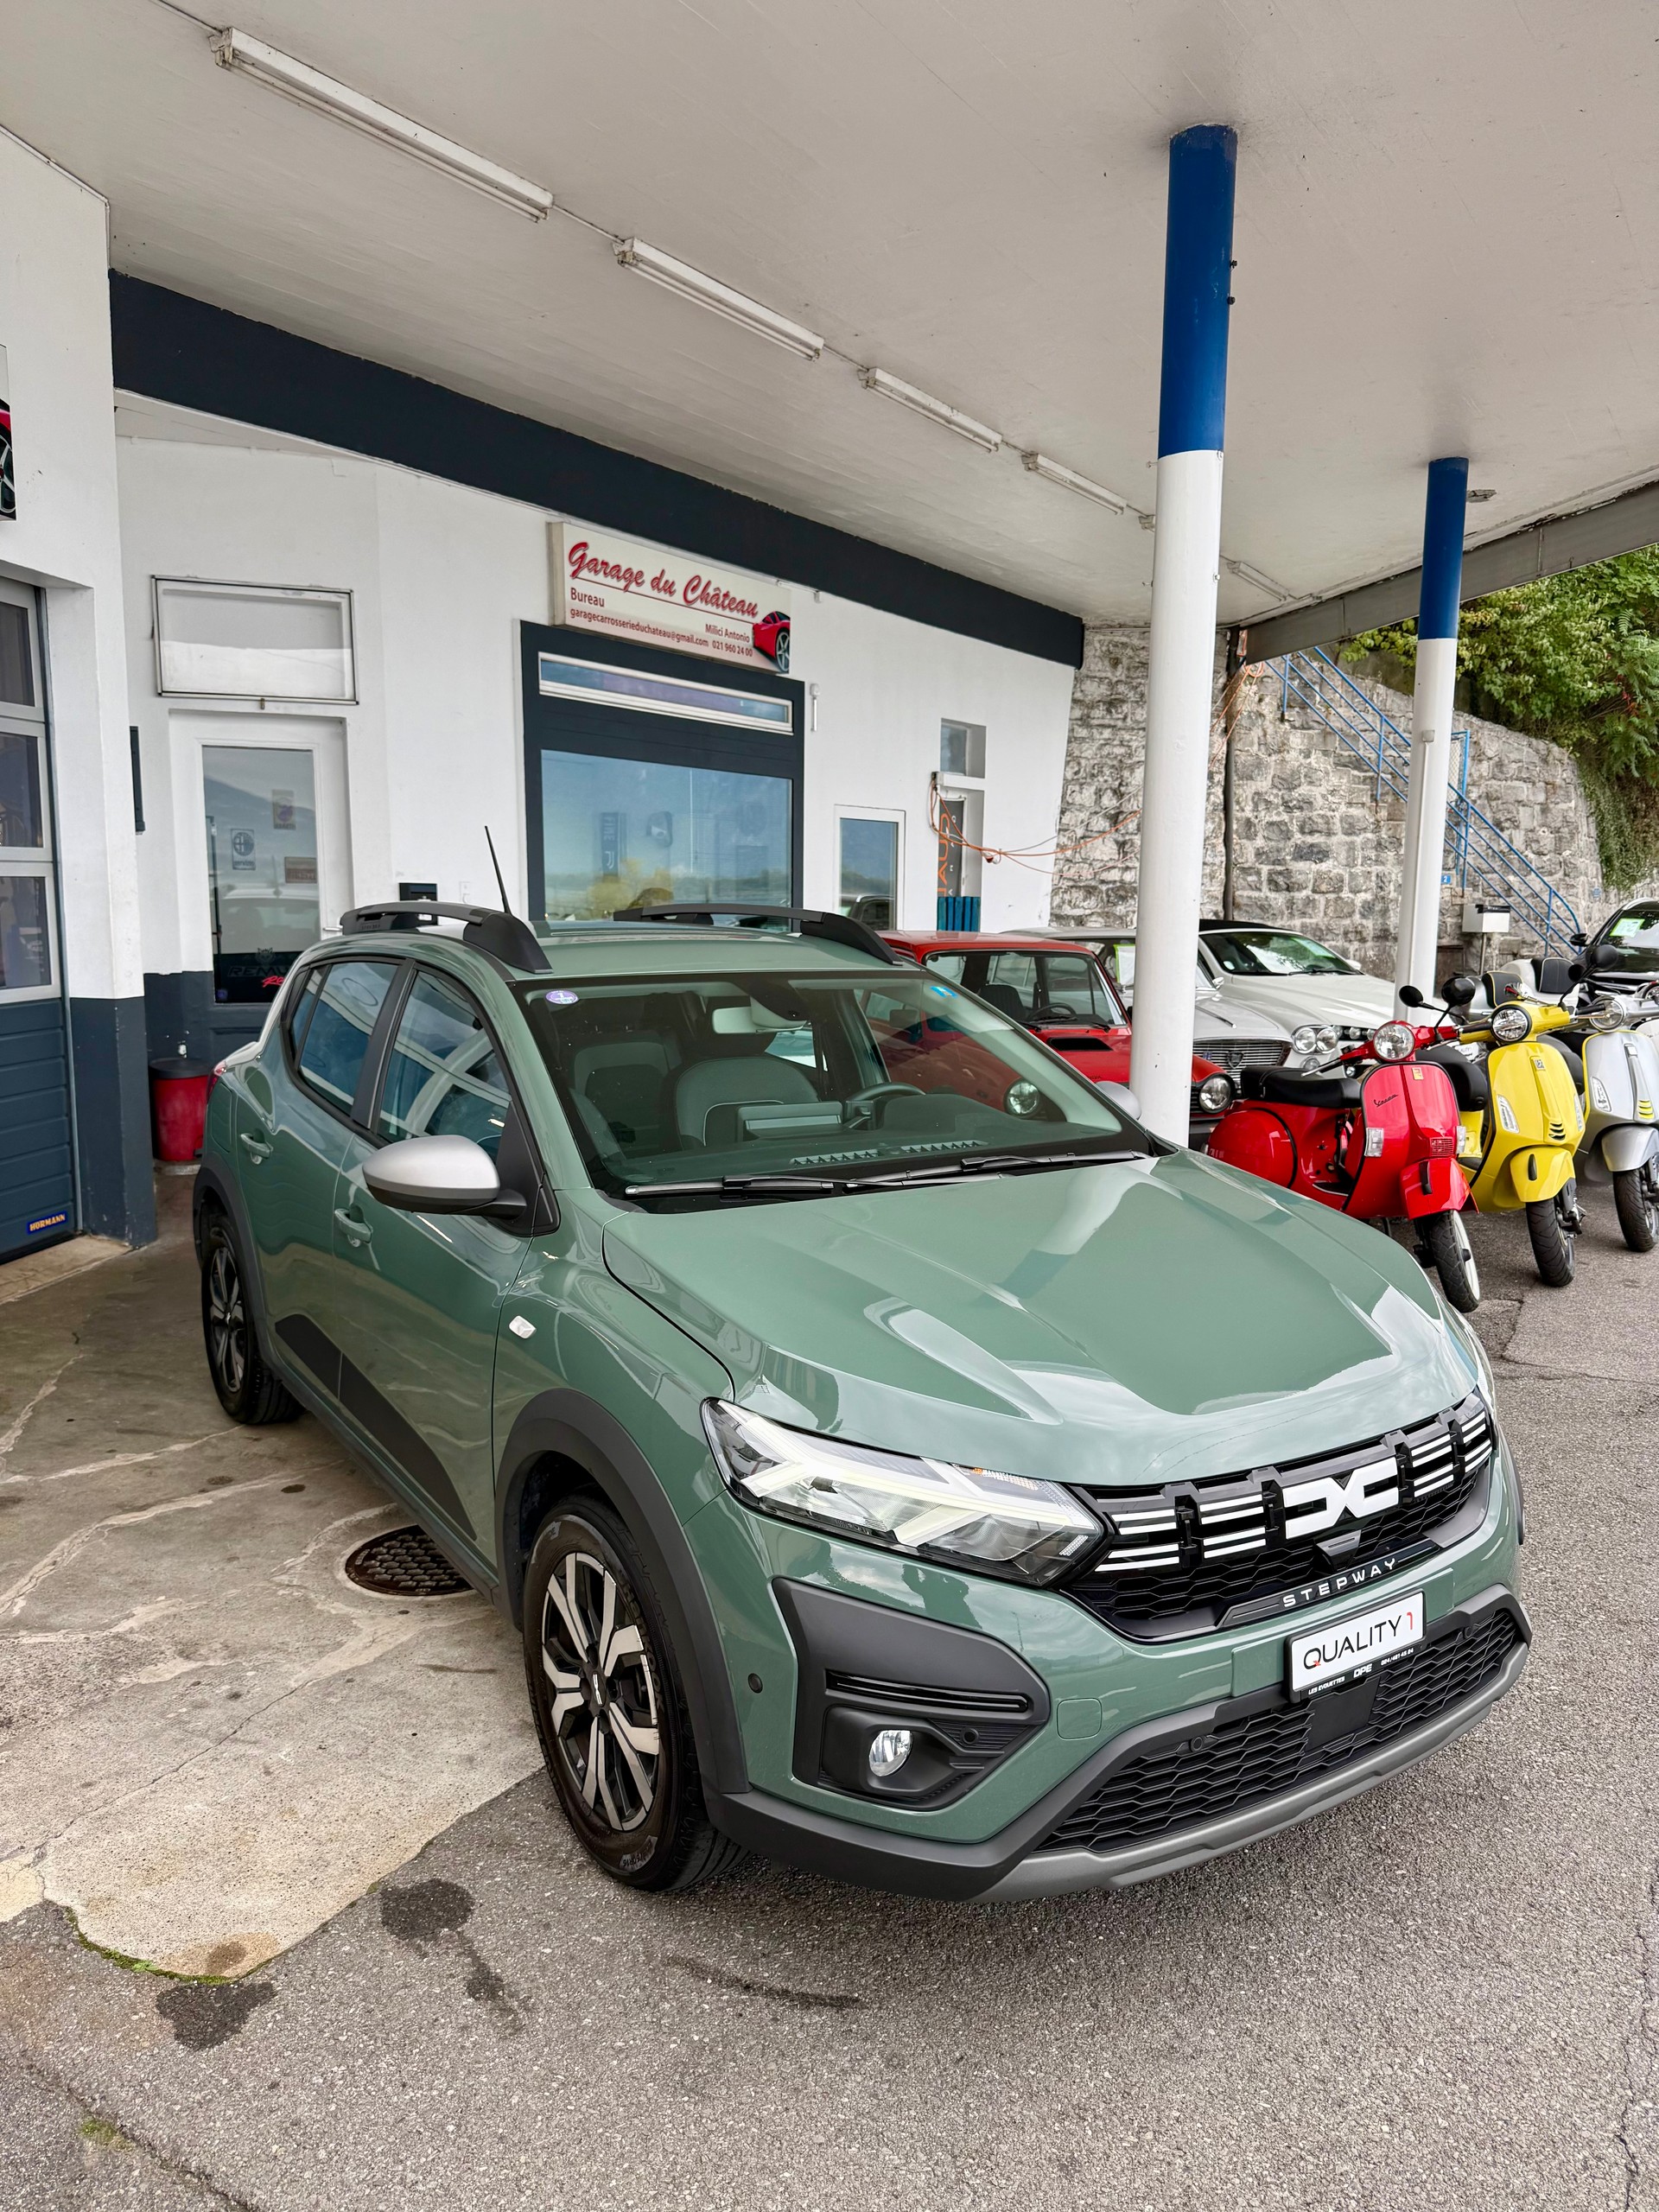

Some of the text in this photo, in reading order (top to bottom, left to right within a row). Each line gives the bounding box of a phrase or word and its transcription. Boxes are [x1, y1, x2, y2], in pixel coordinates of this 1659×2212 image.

[569, 542, 759, 618] Garage du Château
[570, 588, 605, 607] Bureau
[570, 608, 709, 646] garagecarrosserieduchateau@gmail.com
[712, 640, 723, 650] 021
[737, 645, 745, 655] 24
[724, 628, 750, 643] Antonio
[1283, 1558, 1395, 1607] STEPWAY
[1303, 1615, 1402, 1669] QUALITY
[1308, 1687, 1318, 1695] LES
[1353, 1663, 1373, 1678] DPE
